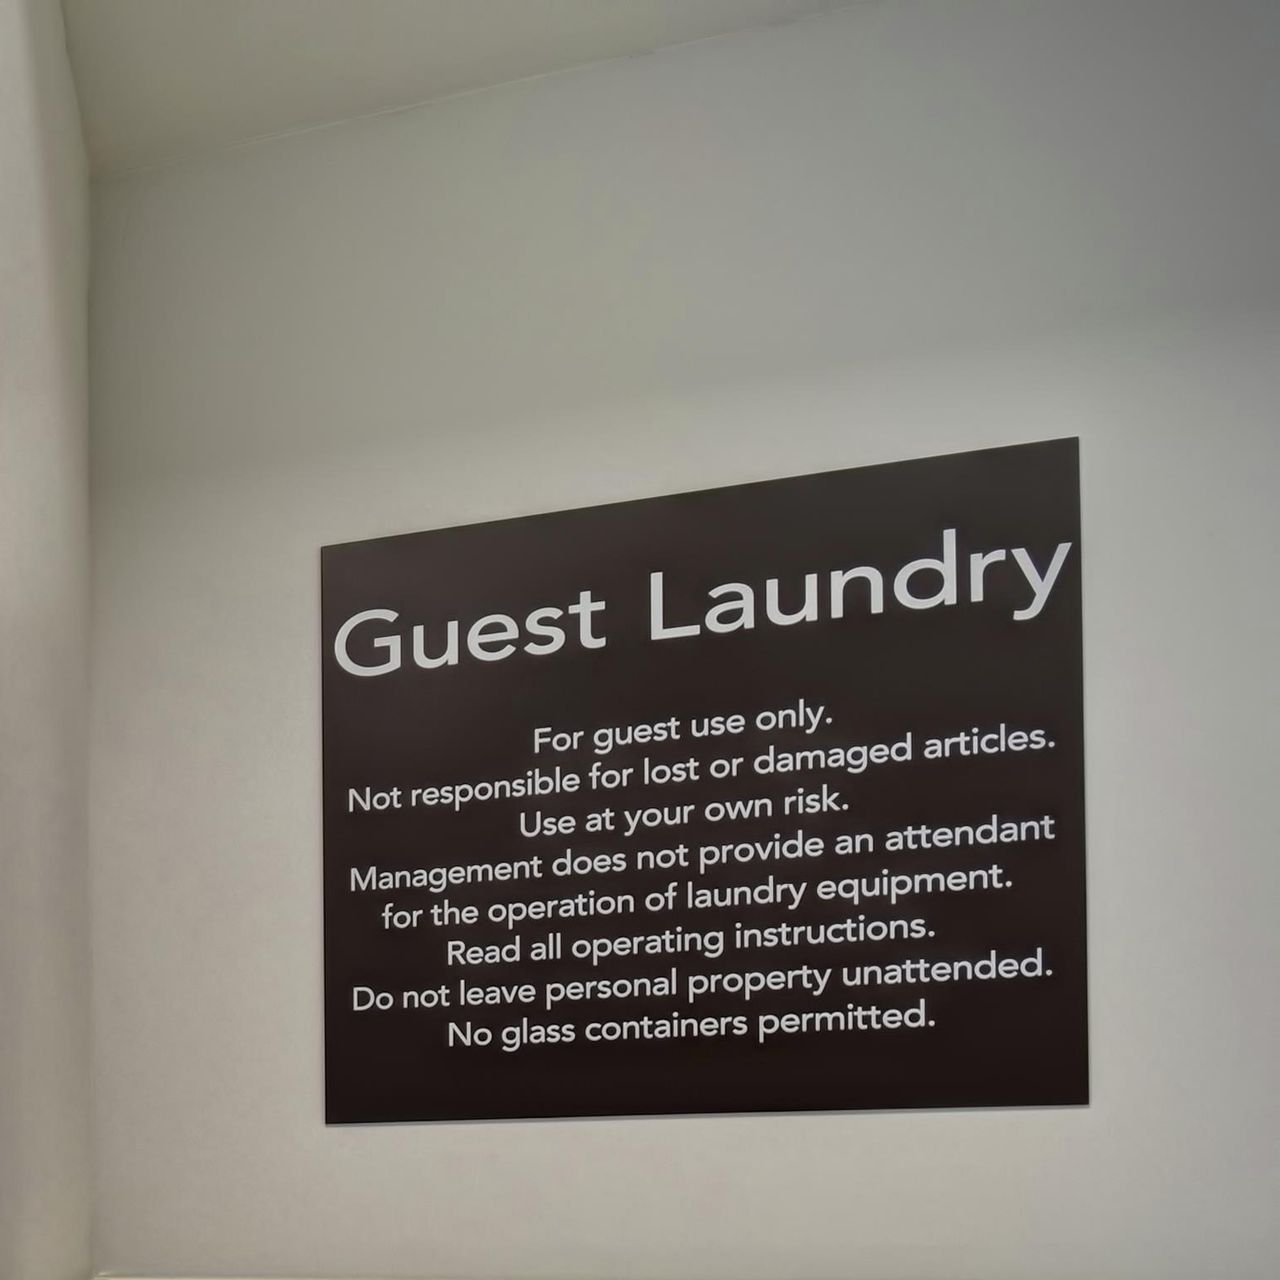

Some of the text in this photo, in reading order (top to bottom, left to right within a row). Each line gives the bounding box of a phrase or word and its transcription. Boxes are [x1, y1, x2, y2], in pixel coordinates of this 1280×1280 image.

[334, 528, 1071, 676] Guest Laundry
[534, 698, 832, 754] For guest use only.
[349, 723, 1054, 812] Not responsible for lost or damaged articles.
[520, 784, 848, 837] Use at your own risk.
[351, 814, 1055, 892] Management does not provide an attendant
[382, 865, 1012, 929] for the operation of laundry equipment.
[448, 914, 934, 965] Read all operating instructions.
[353, 947, 1052, 1010] Do not leave personal property unattended.
[449, 998, 935, 1051] No glass containers permitted.
